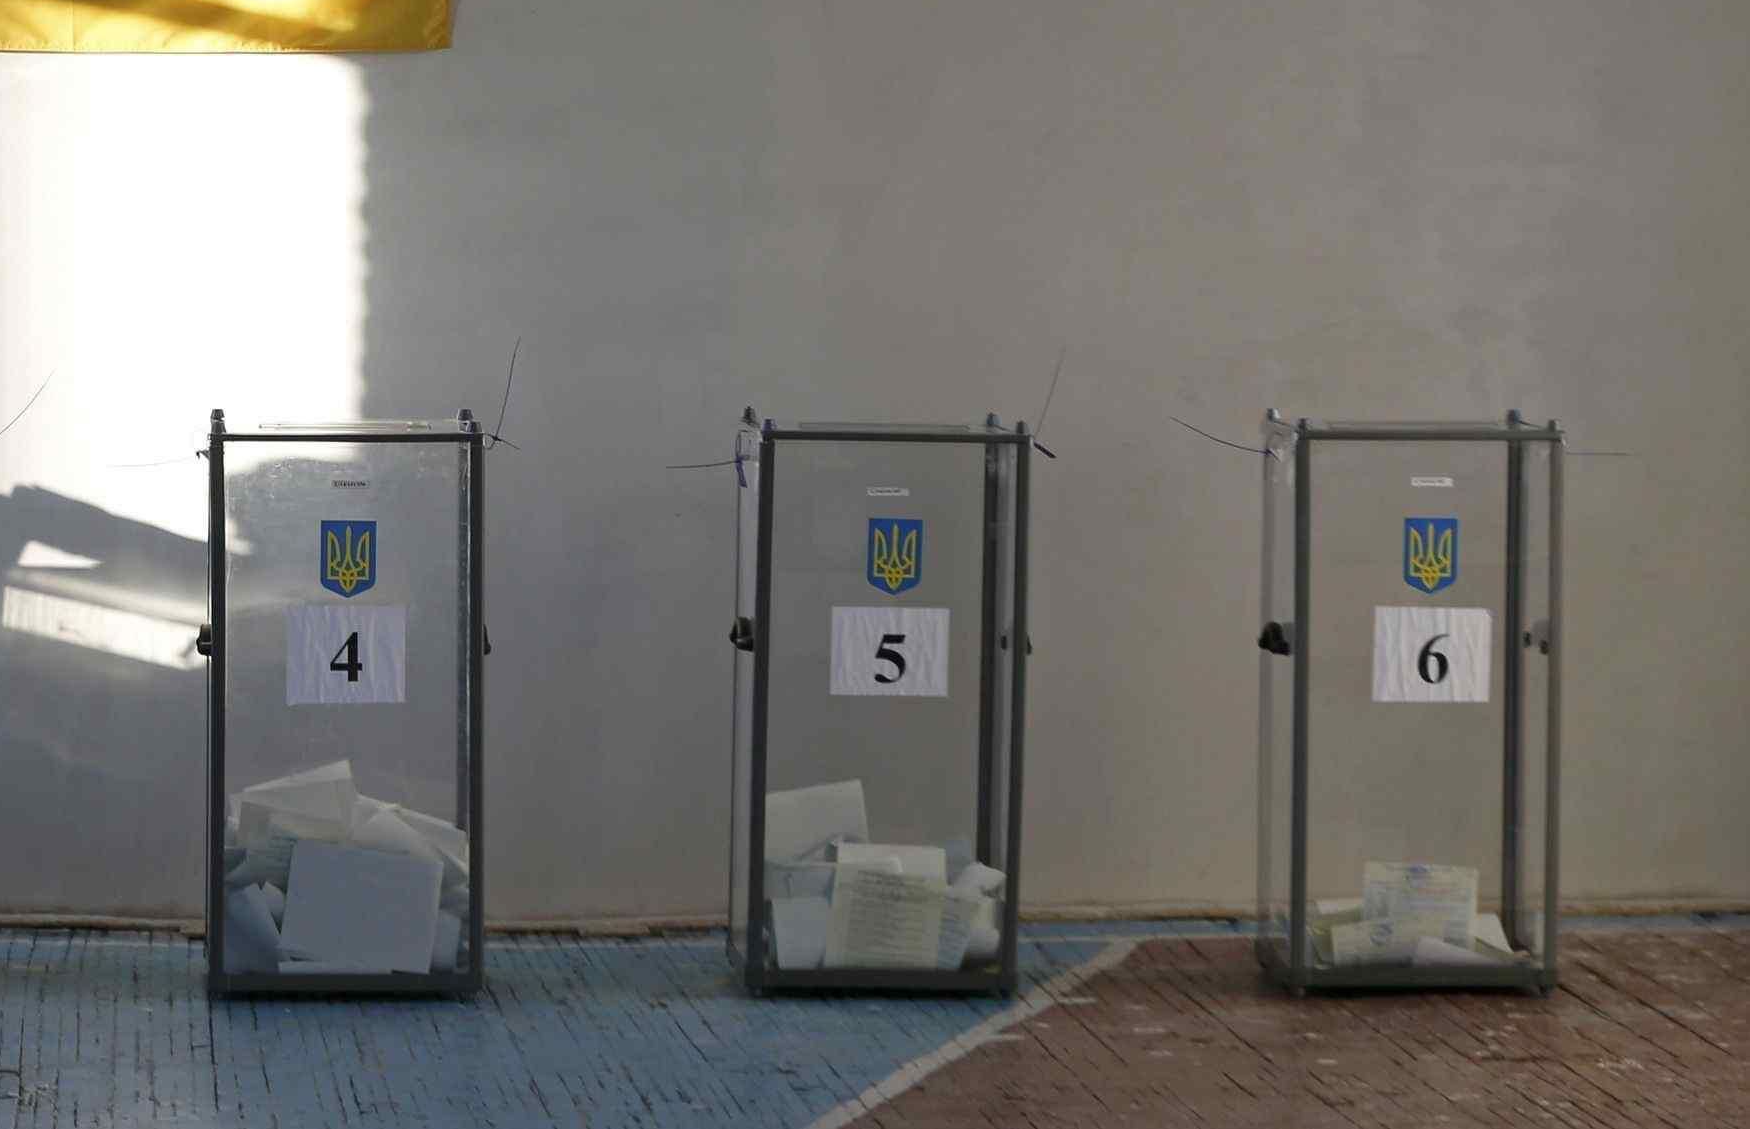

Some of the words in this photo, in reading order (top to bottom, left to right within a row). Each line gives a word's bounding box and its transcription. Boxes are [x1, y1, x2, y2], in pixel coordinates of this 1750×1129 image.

[329, 630, 364, 683] 4
[873, 633, 907, 684] 5
[1416, 634, 1449, 684] 6
